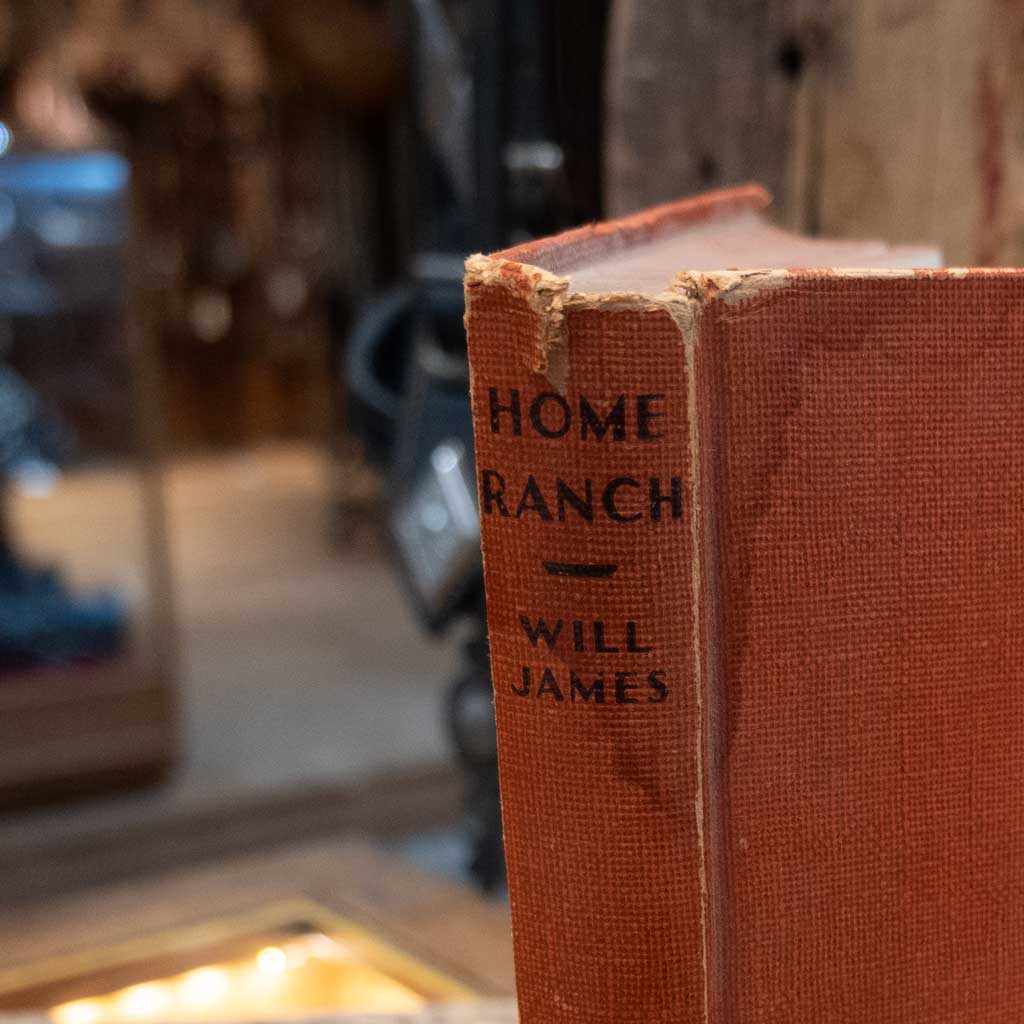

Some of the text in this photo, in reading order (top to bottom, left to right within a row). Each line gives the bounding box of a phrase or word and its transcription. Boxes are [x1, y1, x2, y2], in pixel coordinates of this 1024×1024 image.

[488, 387, 667, 441] HOME
[481, 469, 683, 525] RANCH
[519, 614, 653, 654] WILL
[511, 665, 670, 704] JAMES
